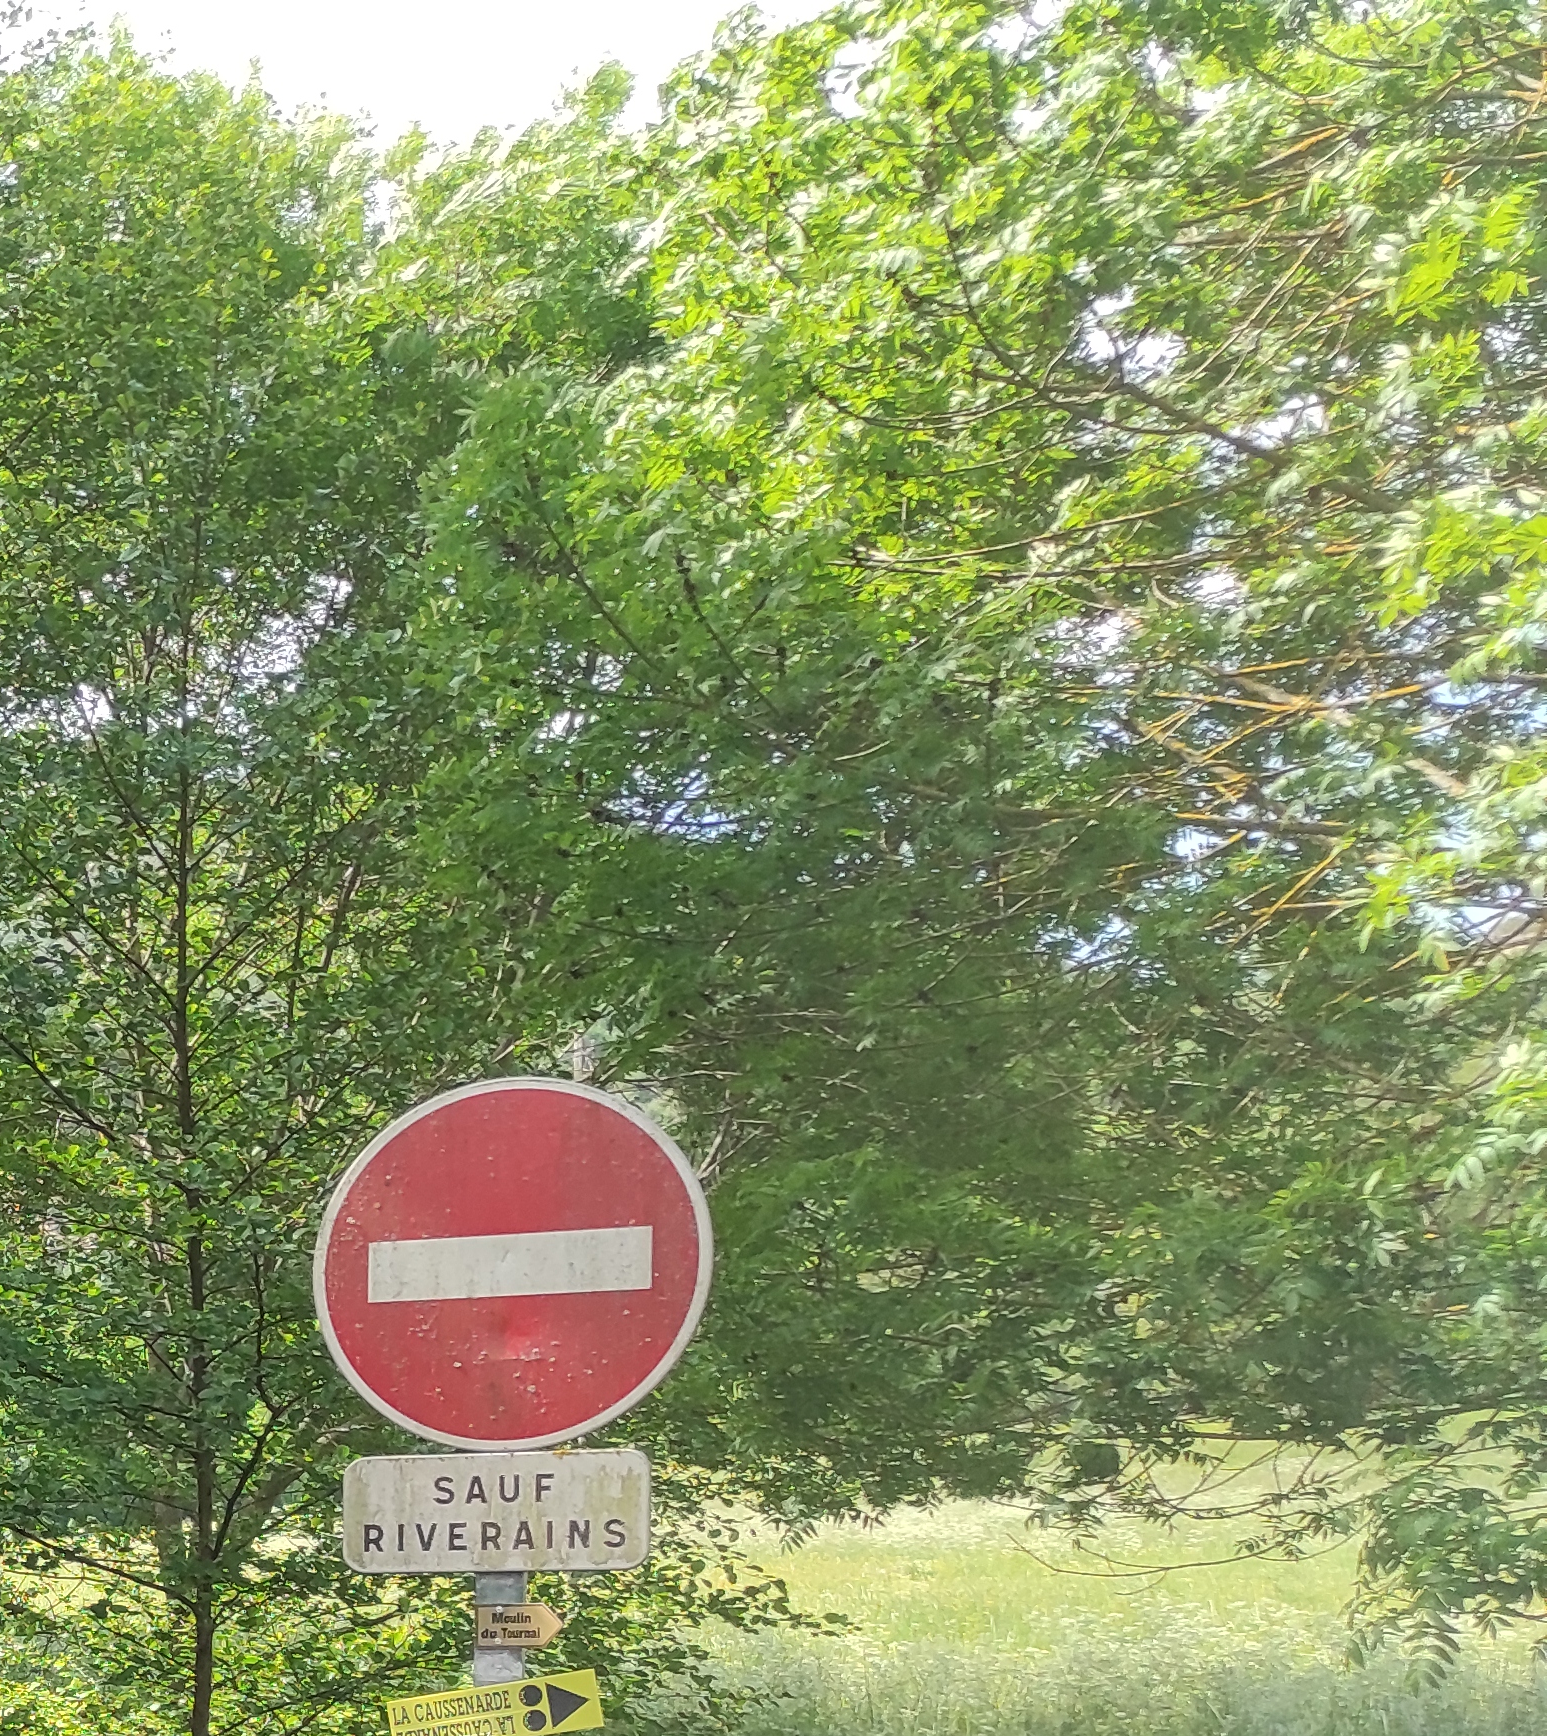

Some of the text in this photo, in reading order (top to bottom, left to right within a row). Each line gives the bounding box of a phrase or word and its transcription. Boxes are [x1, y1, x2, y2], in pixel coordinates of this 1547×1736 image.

[433, 1473, 555, 1505] SAUF
[363, 1518, 627, 1553] RIVERAINS
[491, 1611, 532, 1625] Moulin
[392, 1689, 512, 1726] LA CAUSSENARDE
[495, 1714, 516, 1735] LA
